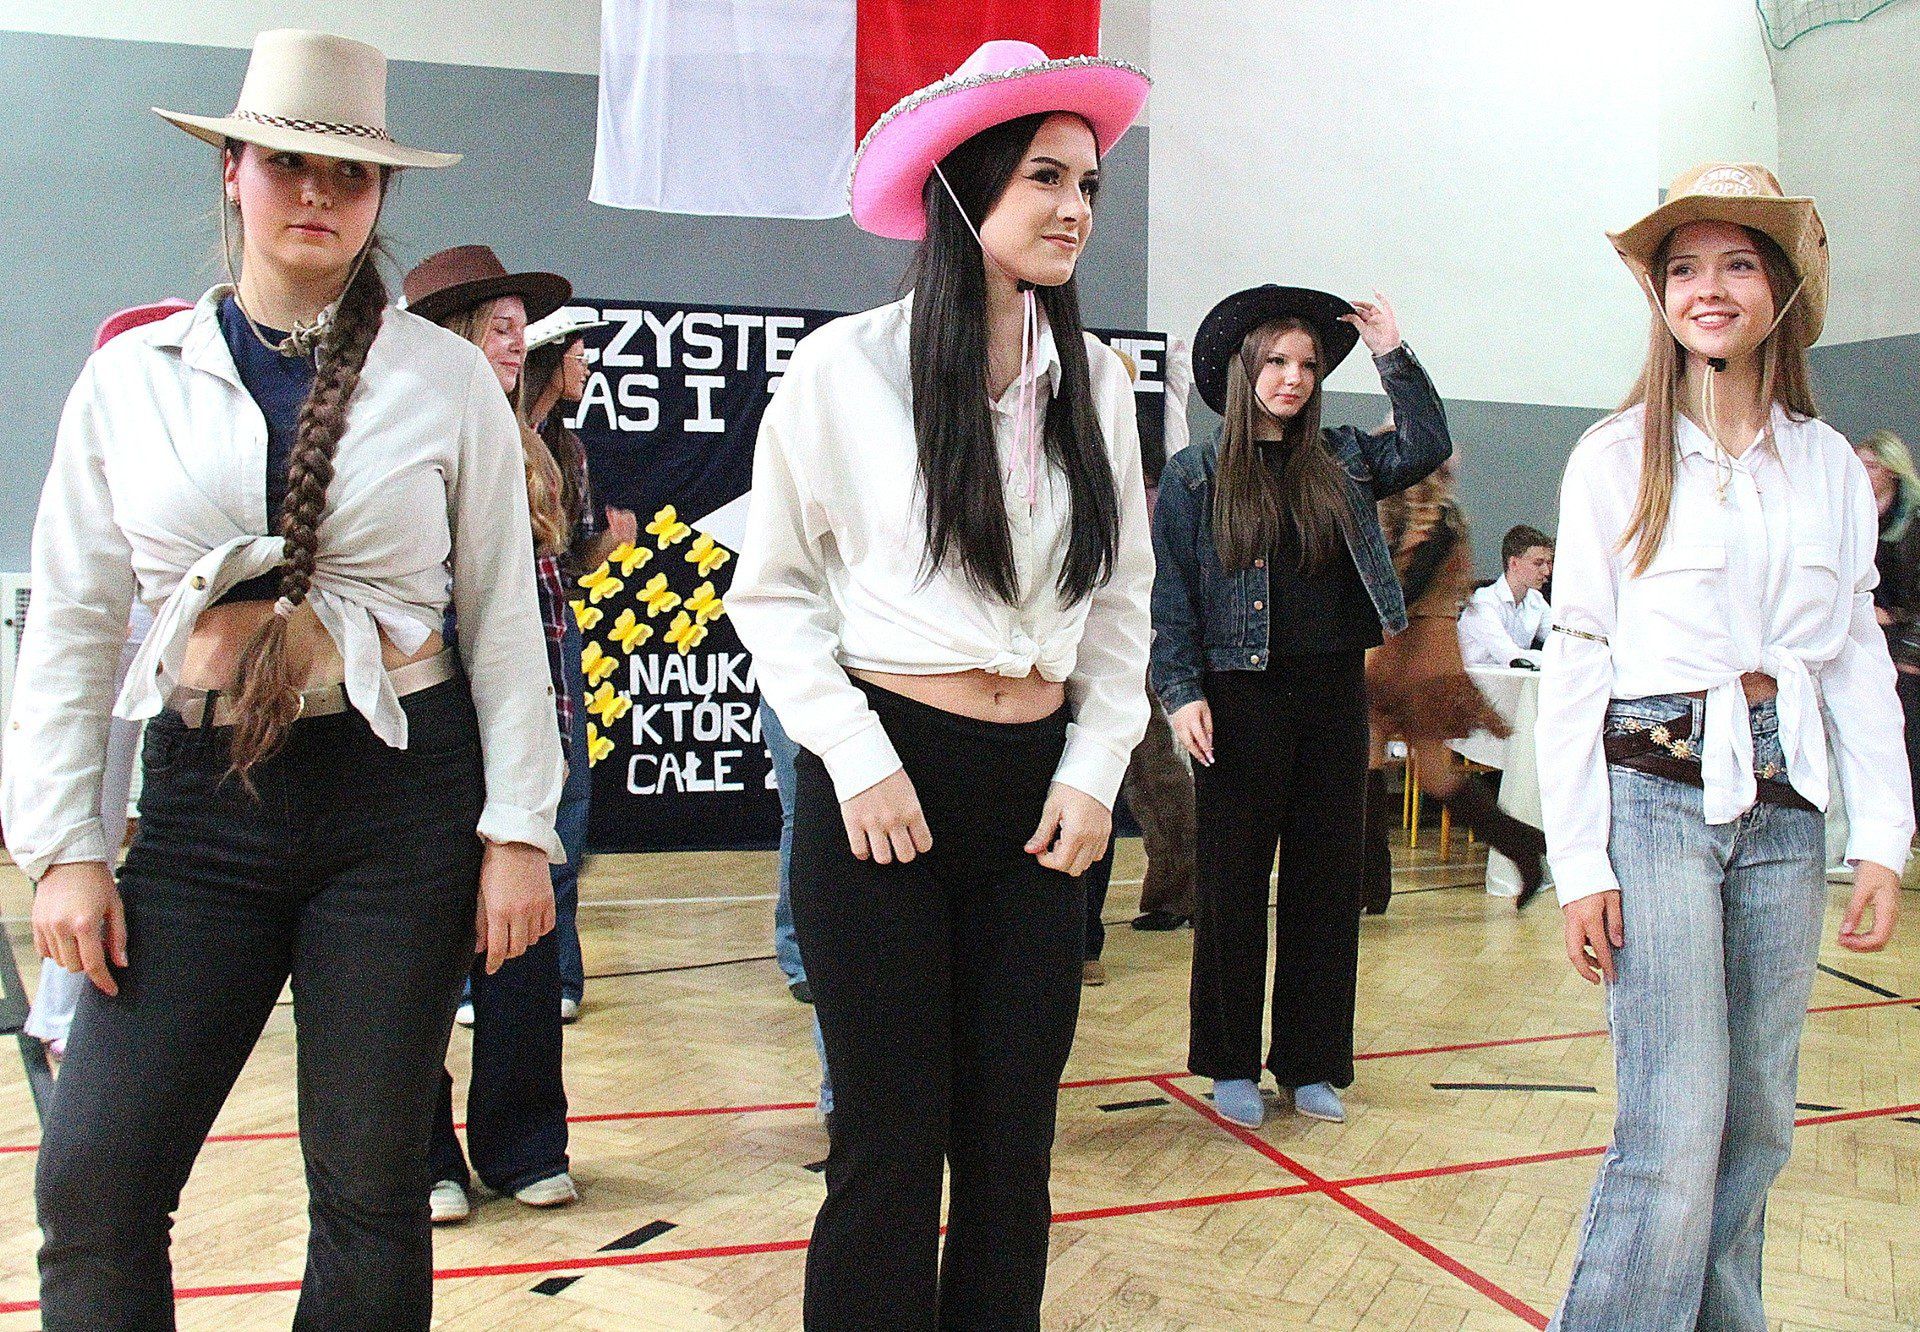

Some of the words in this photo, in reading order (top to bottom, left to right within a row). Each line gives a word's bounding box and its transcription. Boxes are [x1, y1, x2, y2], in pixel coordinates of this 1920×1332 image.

[563, 371, 660, 432] AS
[684, 375, 726, 433] I
[626, 750, 745, 795] CAŁE
